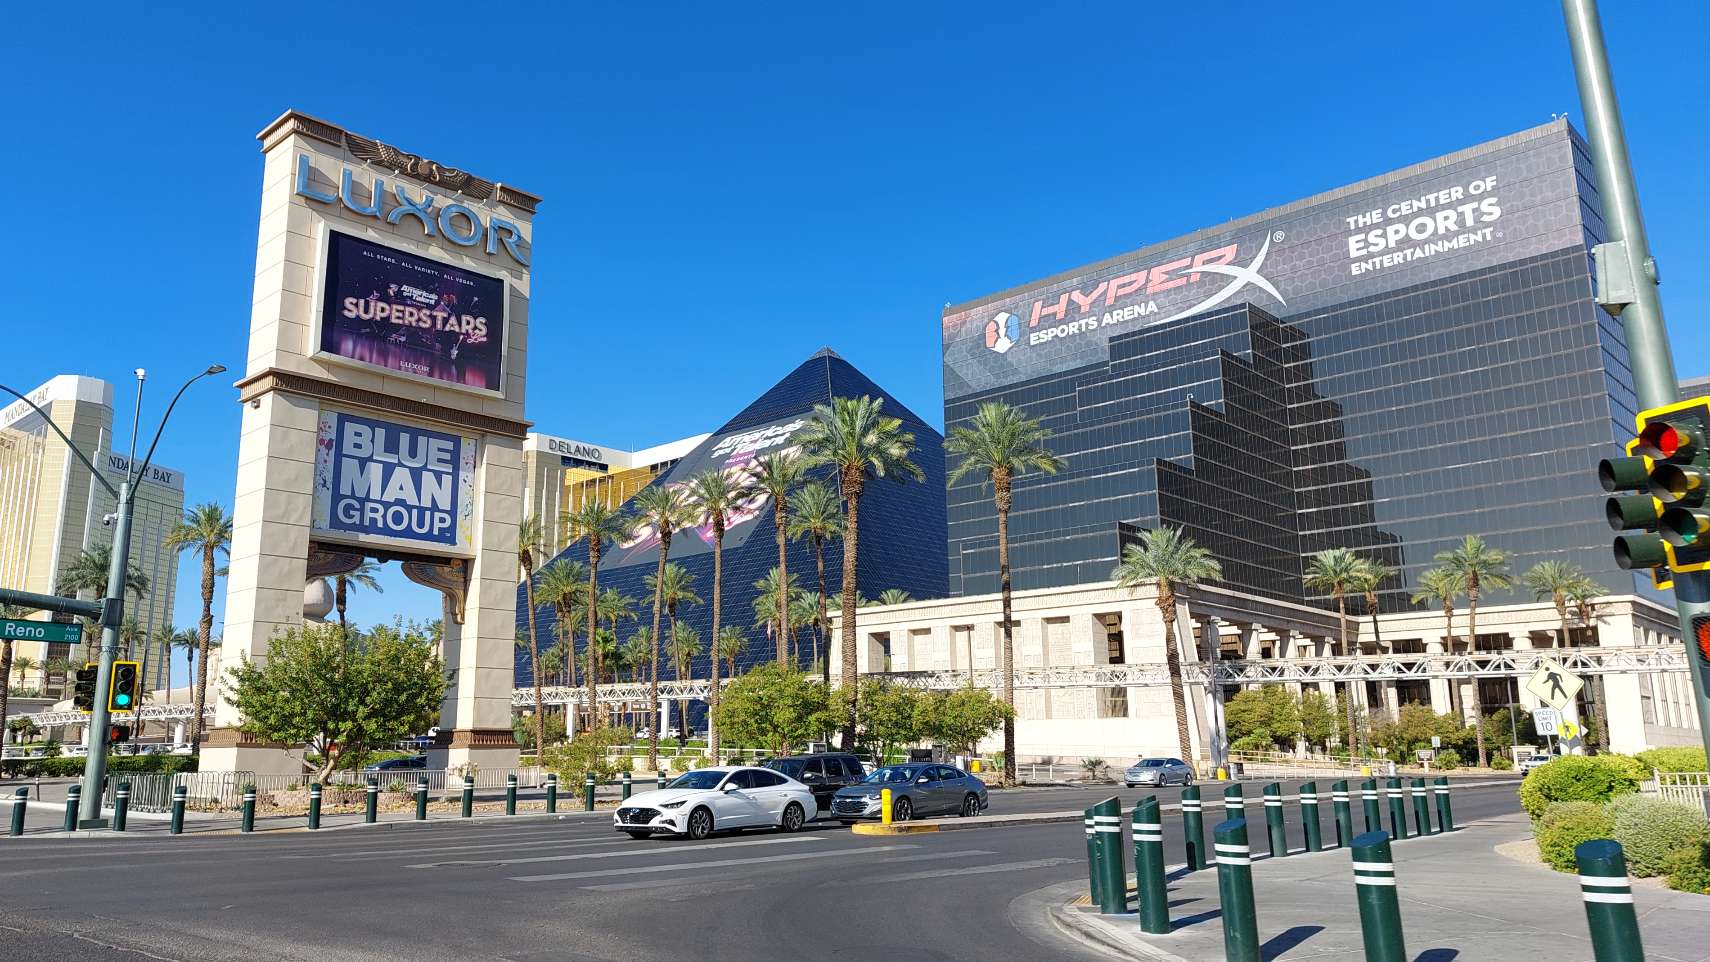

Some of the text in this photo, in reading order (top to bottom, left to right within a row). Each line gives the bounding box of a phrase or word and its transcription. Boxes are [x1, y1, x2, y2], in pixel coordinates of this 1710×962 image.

[294, 153, 529, 267] LUXOR
[1346, 175, 1497, 230] THE CENTER OF
[1348, 197, 1502, 259] ESPORTS
[1351, 227, 1494, 275] ENTERTAINMENT
[343, 296, 488, 337] SUPERSTARS
[1029, 301, 1158, 346] ESPORTS ARENA
[342, 421, 454, 472] BLUE
[548, 438, 601, 460] DELANO
[153, 468, 173, 484] BAY
[339, 457, 452, 511] MAN
[337, 498, 452, 536] GROUP
[4, 622, 45, 638] Reno
[1541, 721, 1553, 732] 10
